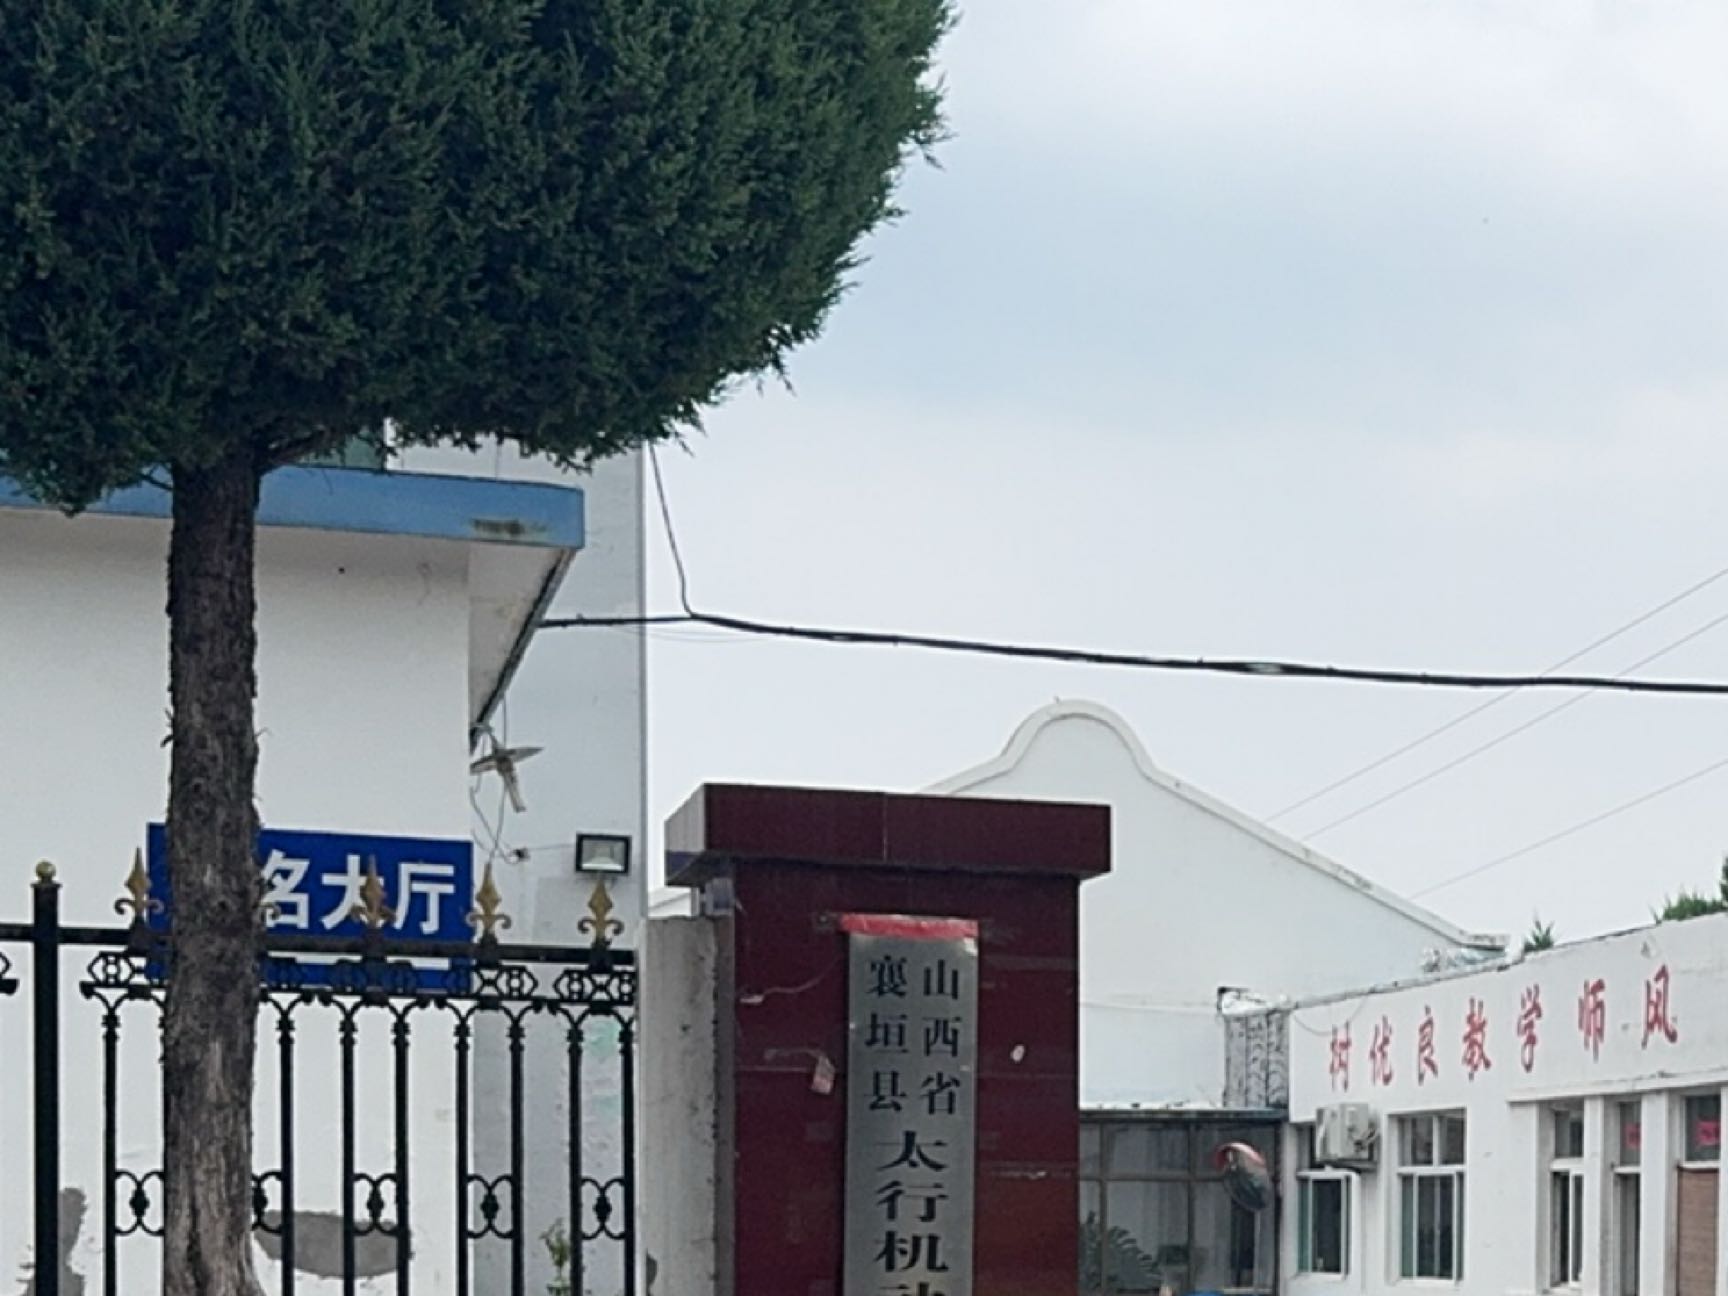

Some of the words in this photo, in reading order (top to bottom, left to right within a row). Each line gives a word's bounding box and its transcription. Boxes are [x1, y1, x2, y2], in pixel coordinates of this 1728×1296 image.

[259, 849, 455, 935] 名大厅
[864, 955, 908, 1111] 襄垣县
[921, 959, 961, 1115] 山西省
